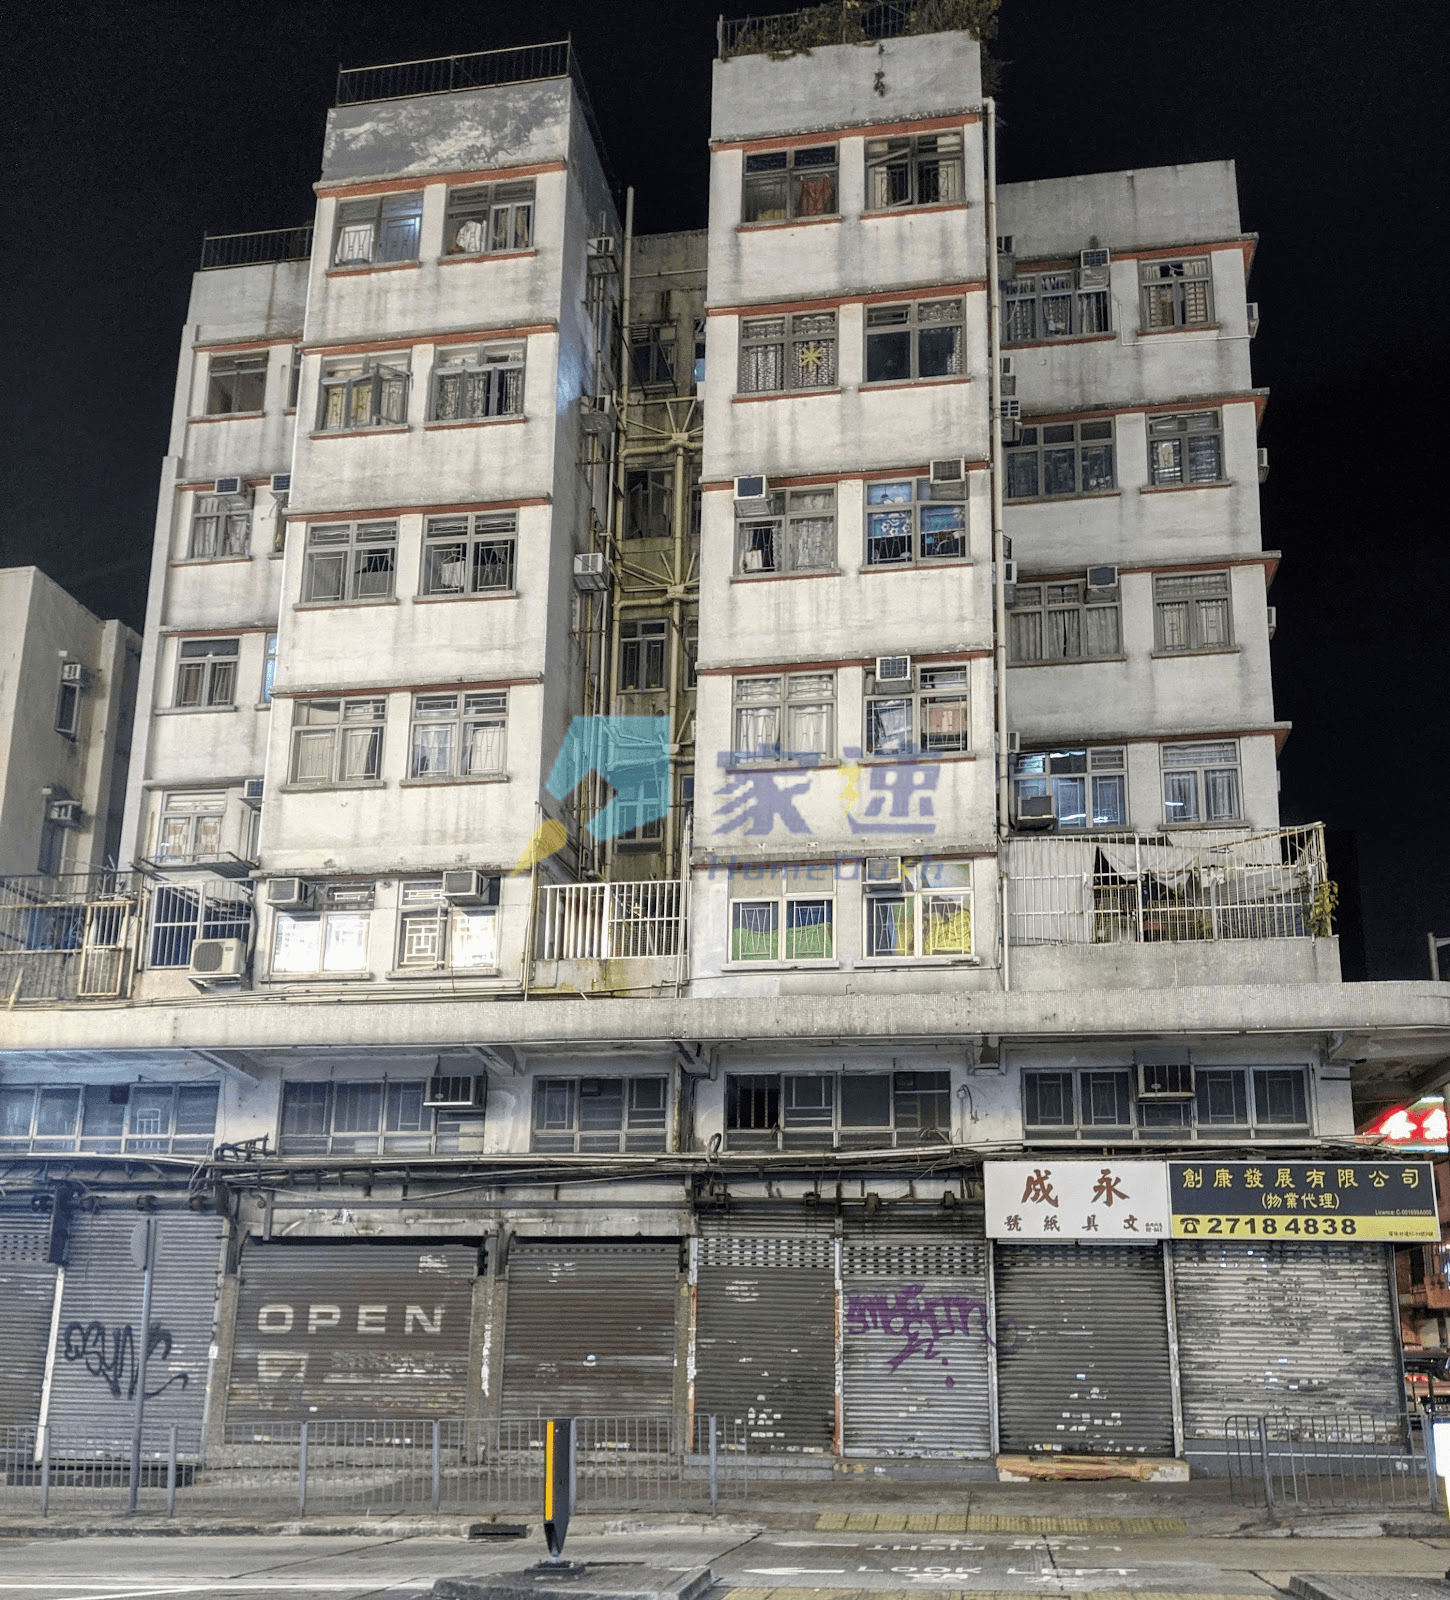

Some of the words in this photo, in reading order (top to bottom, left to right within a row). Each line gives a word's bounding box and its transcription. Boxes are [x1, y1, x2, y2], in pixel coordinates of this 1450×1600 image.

[1183, 1168, 1420, 1189] 創康發展有限公司
[1261, 1192, 1340, 1210] (物業代理)
[257, 1304, 444, 1335] OPEN
[857, 1566, 982, 1574] LOOK
